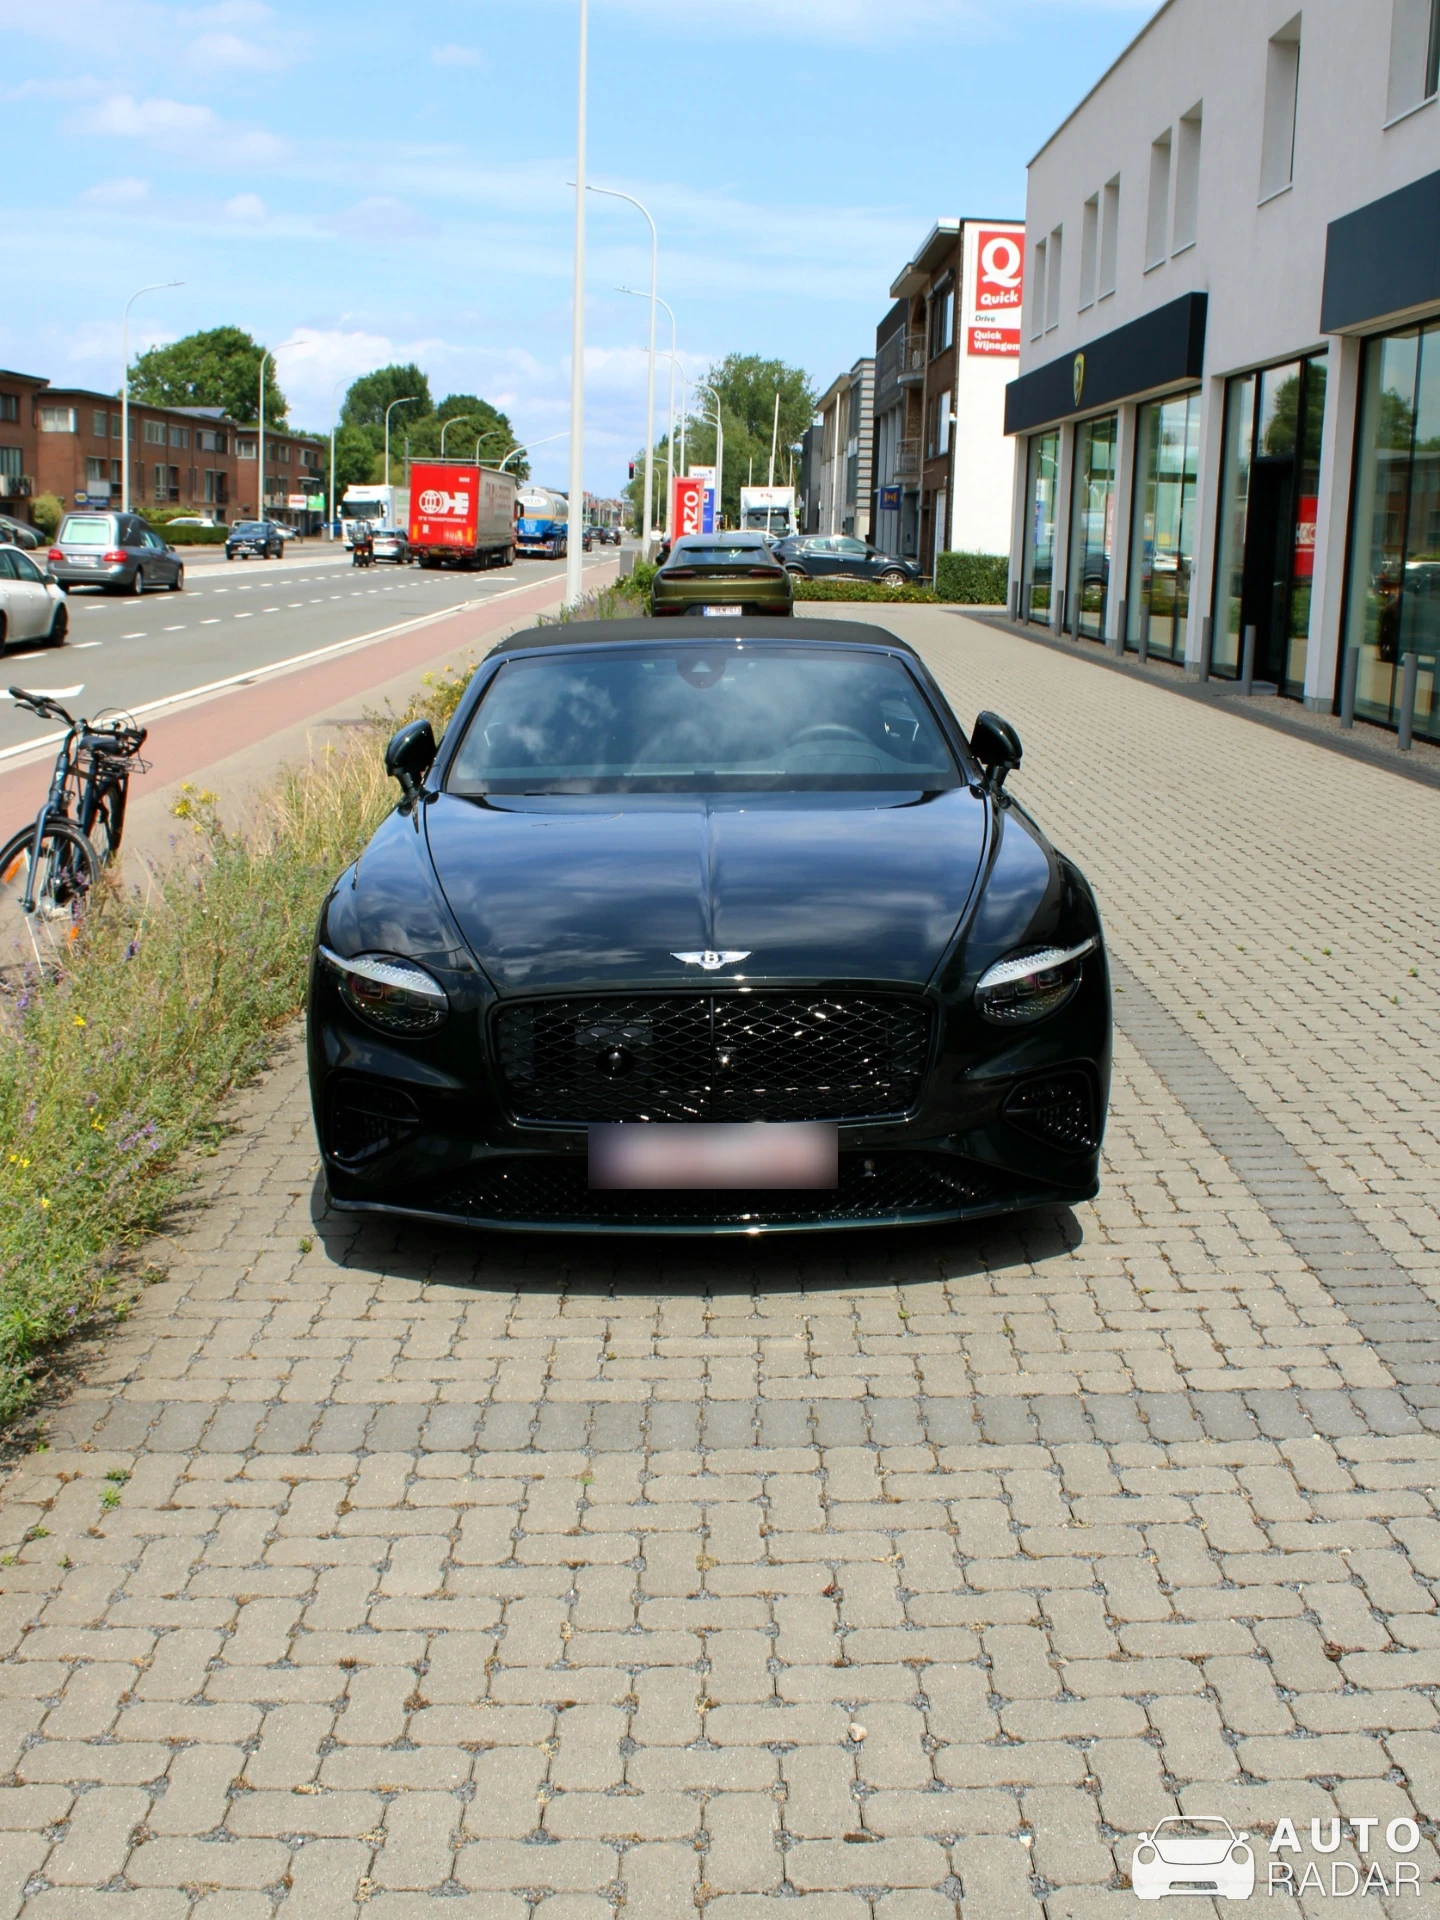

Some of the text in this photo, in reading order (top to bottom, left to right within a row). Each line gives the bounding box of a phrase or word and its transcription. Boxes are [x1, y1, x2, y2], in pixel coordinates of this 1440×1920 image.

[981, 237, 1022, 288] Q
[980, 290, 1019, 306] Quick
[975, 315, 996, 323] Drive
[974, 330, 1002, 340] Quick
[704, 951, 719, 963] B
